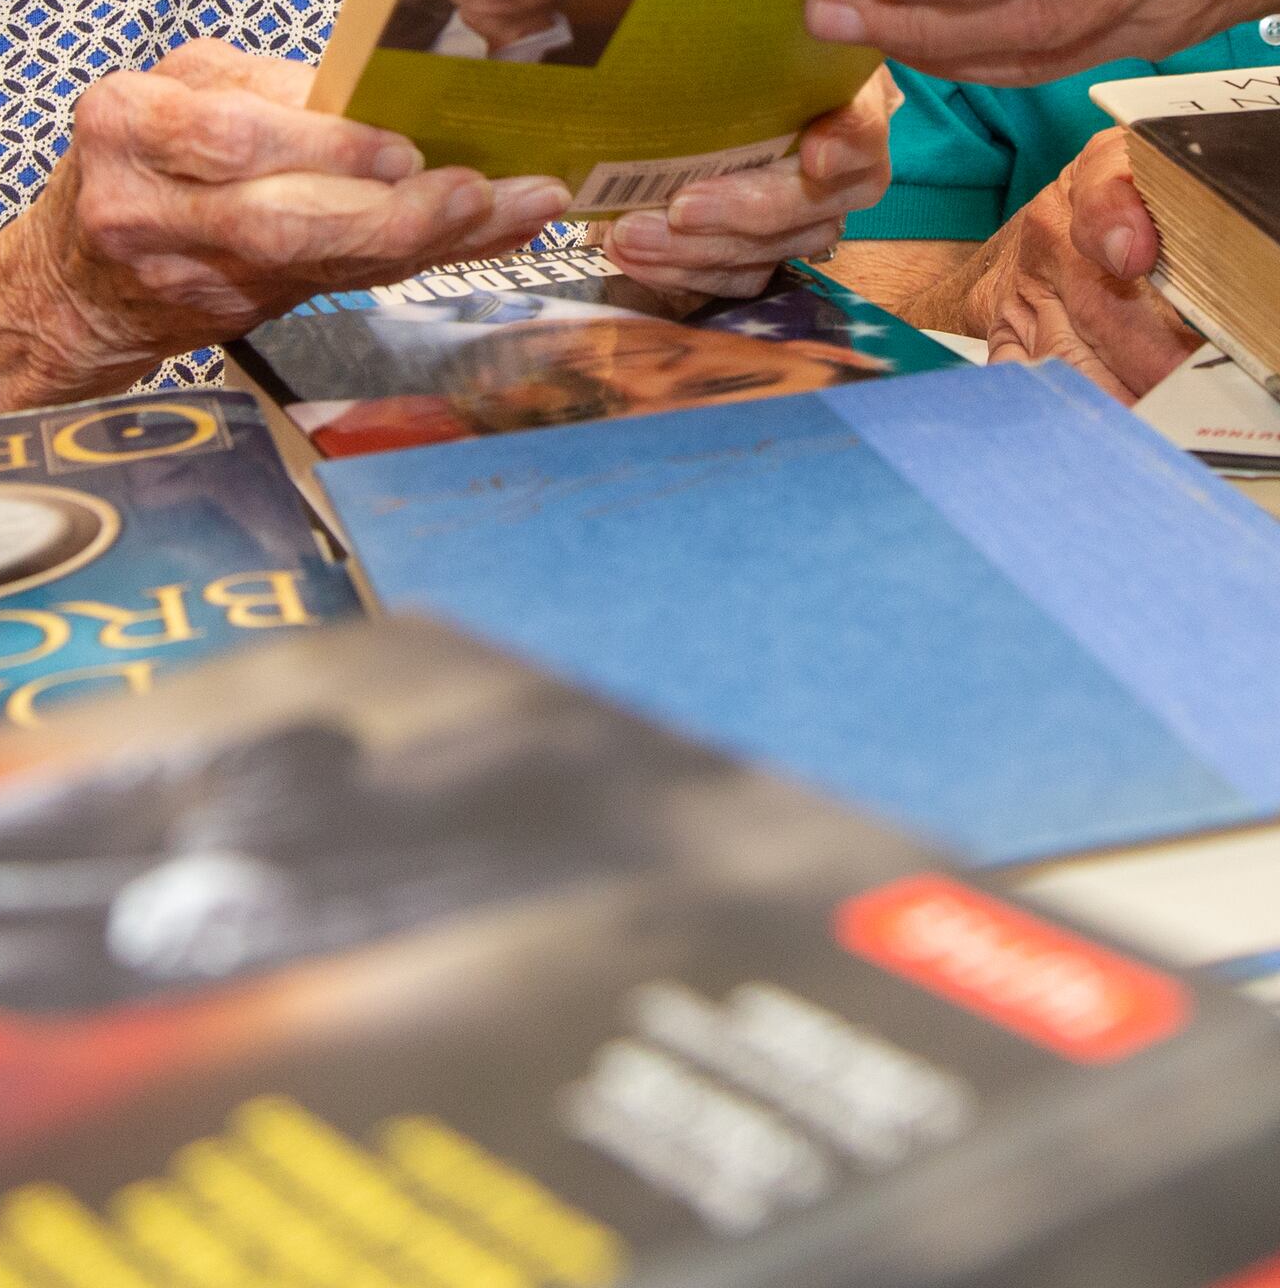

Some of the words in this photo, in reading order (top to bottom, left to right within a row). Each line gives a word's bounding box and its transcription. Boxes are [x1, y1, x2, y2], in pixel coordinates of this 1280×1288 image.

[512, 252, 537, 267] OF
[538, 247, 586, 264] WAR
[368, 254, 624, 307] REEDOM
